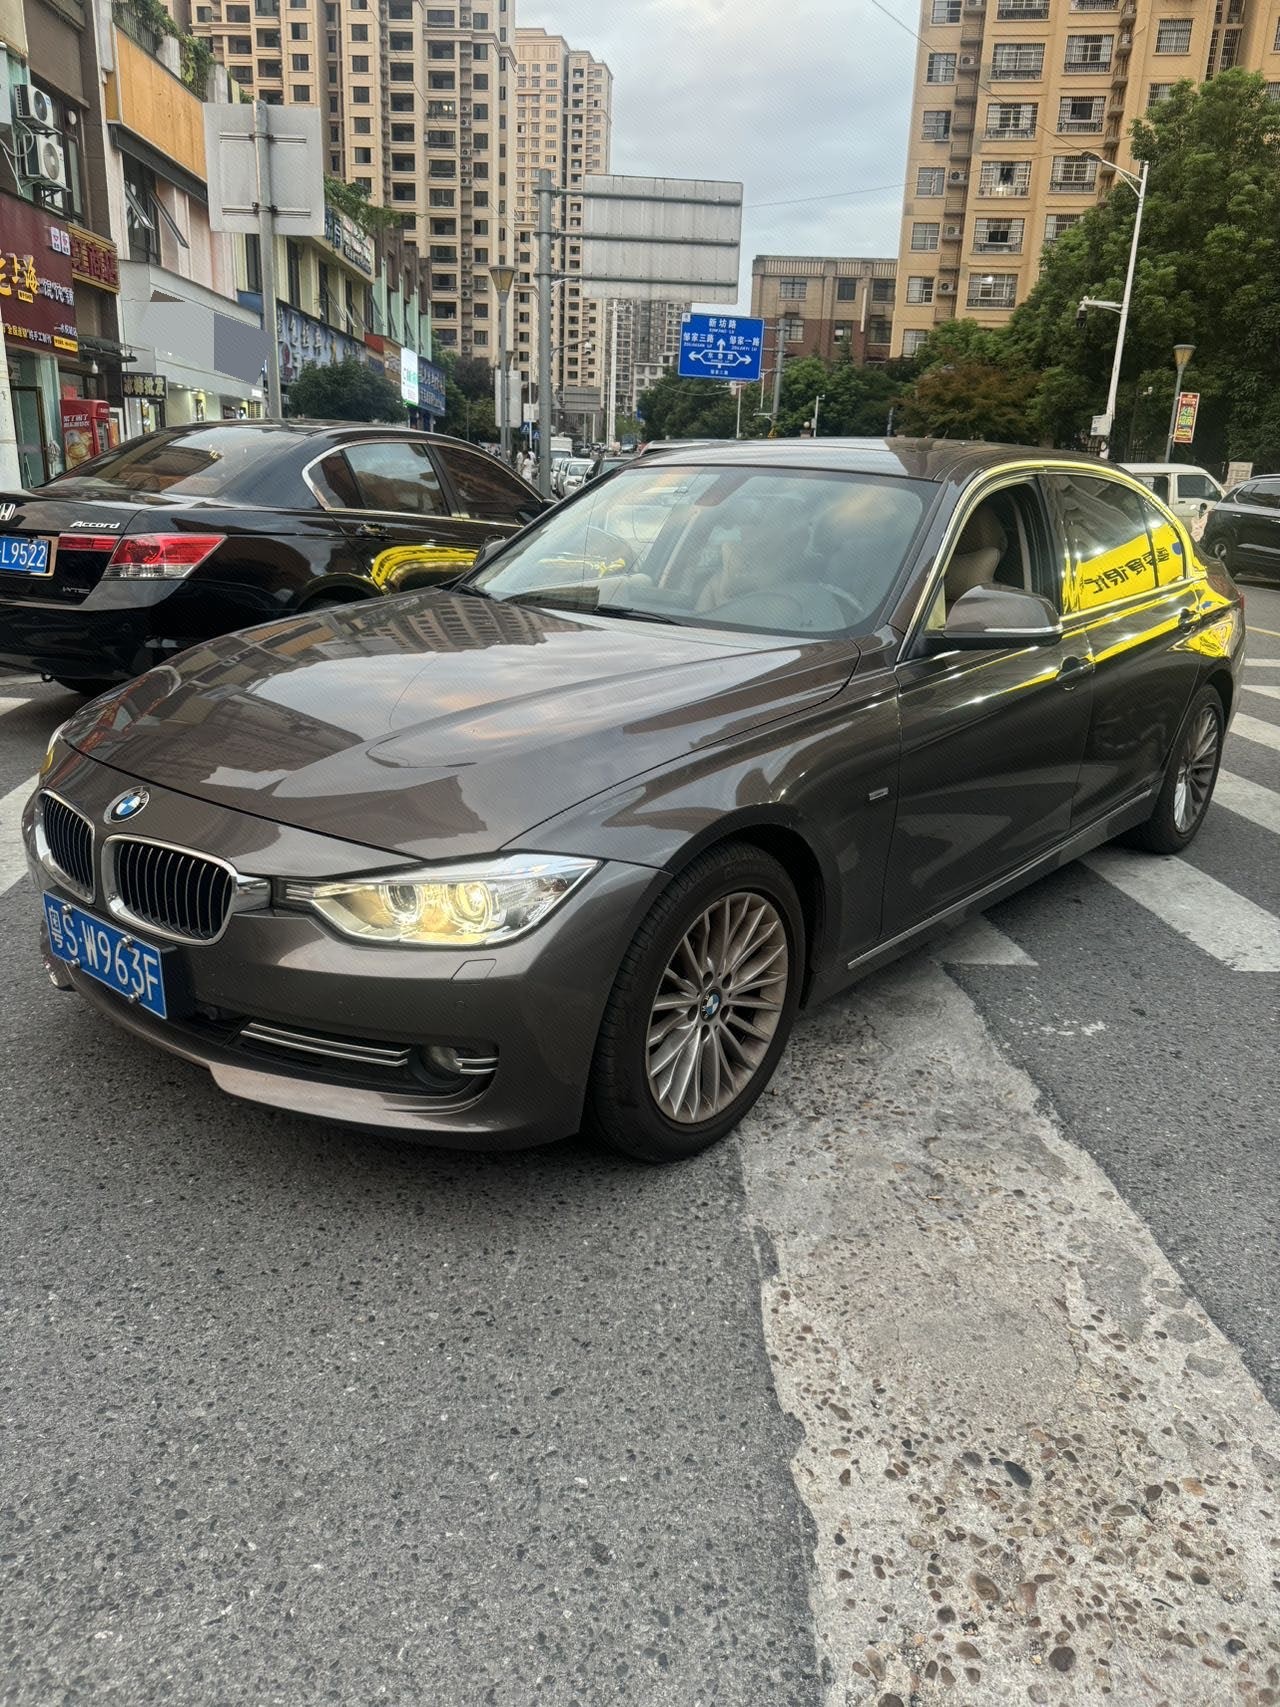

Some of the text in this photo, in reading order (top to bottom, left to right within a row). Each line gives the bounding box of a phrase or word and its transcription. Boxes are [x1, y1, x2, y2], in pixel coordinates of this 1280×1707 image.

[709, 318, 736, 329] 新坊路
[683, 332, 714, 343] 邹家三路
[729, 335, 760, 347] 邹家一路
[70, 521, 120, 529] Accord
